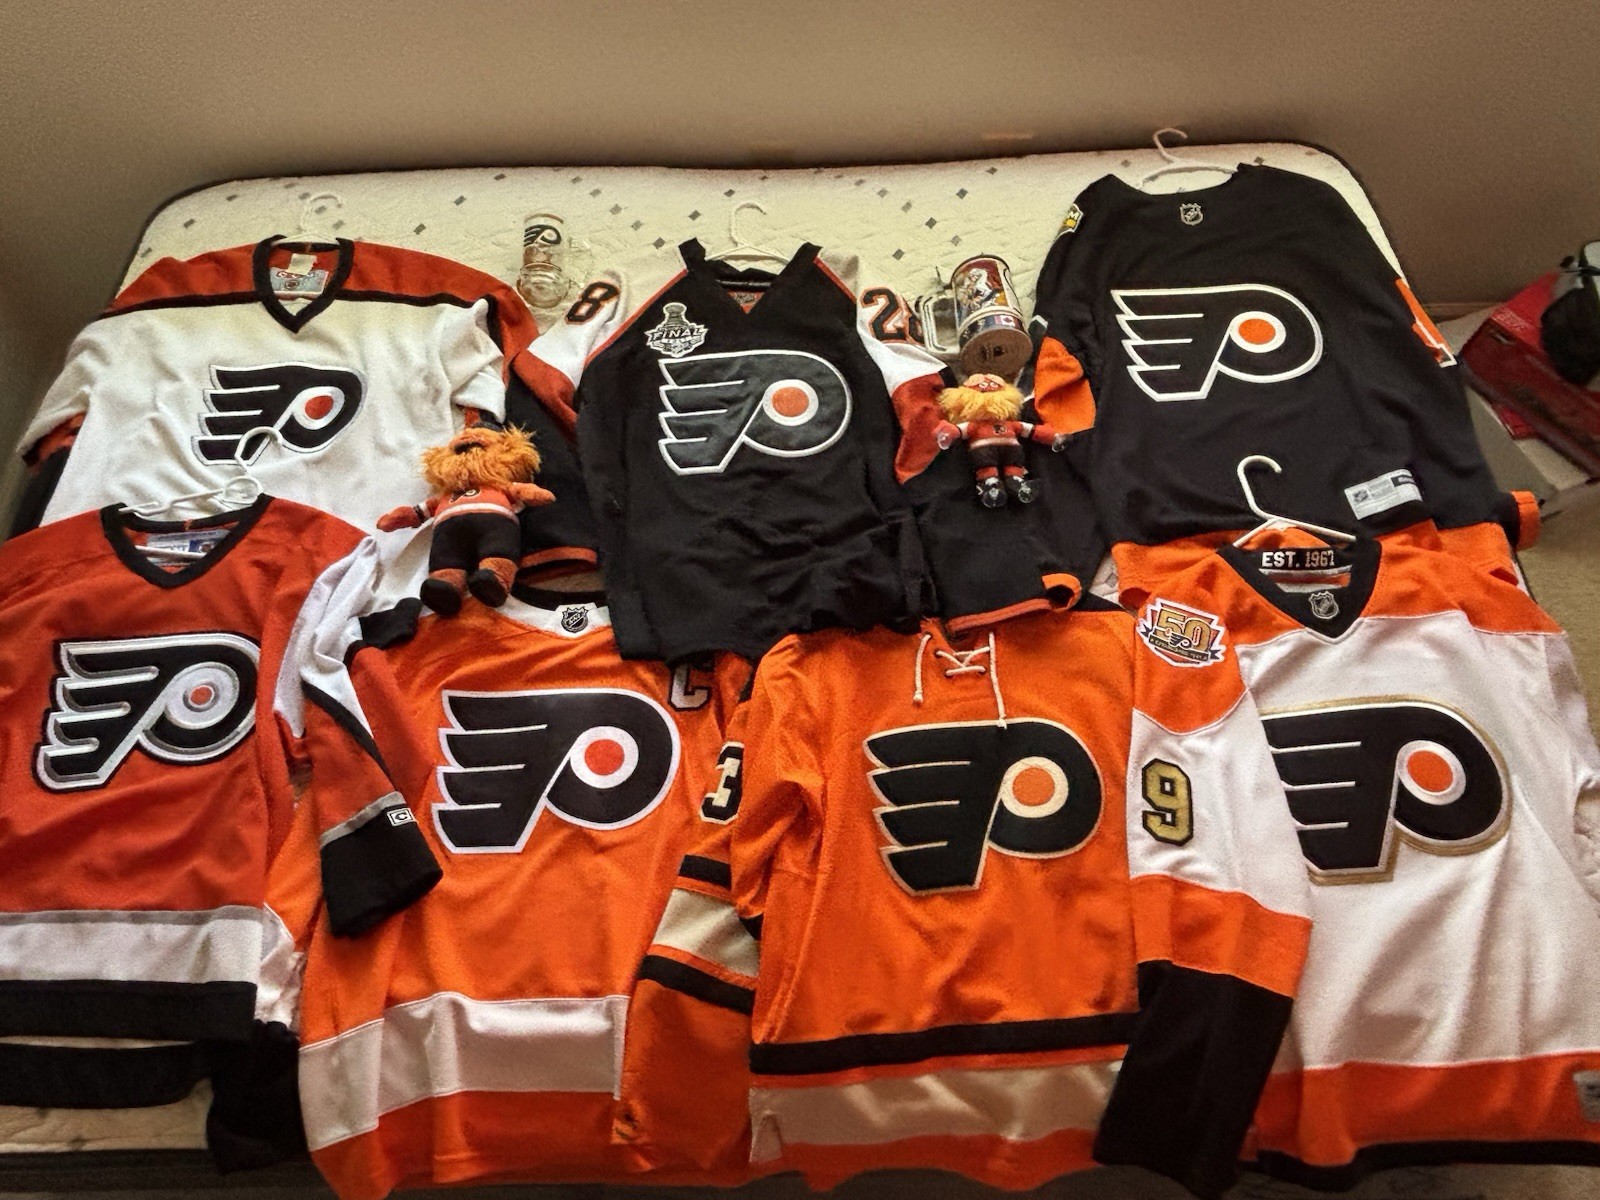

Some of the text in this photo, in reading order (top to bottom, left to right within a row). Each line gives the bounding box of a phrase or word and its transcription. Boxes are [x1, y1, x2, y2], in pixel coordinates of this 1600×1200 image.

[565, 281, 620, 325] 8
[652, 327, 702, 341] FINAL
[1261, 550, 1335, 567] EST. 1967
[1153, 606, 1212, 653] 50
[1142, 758, 1194, 847] 9
